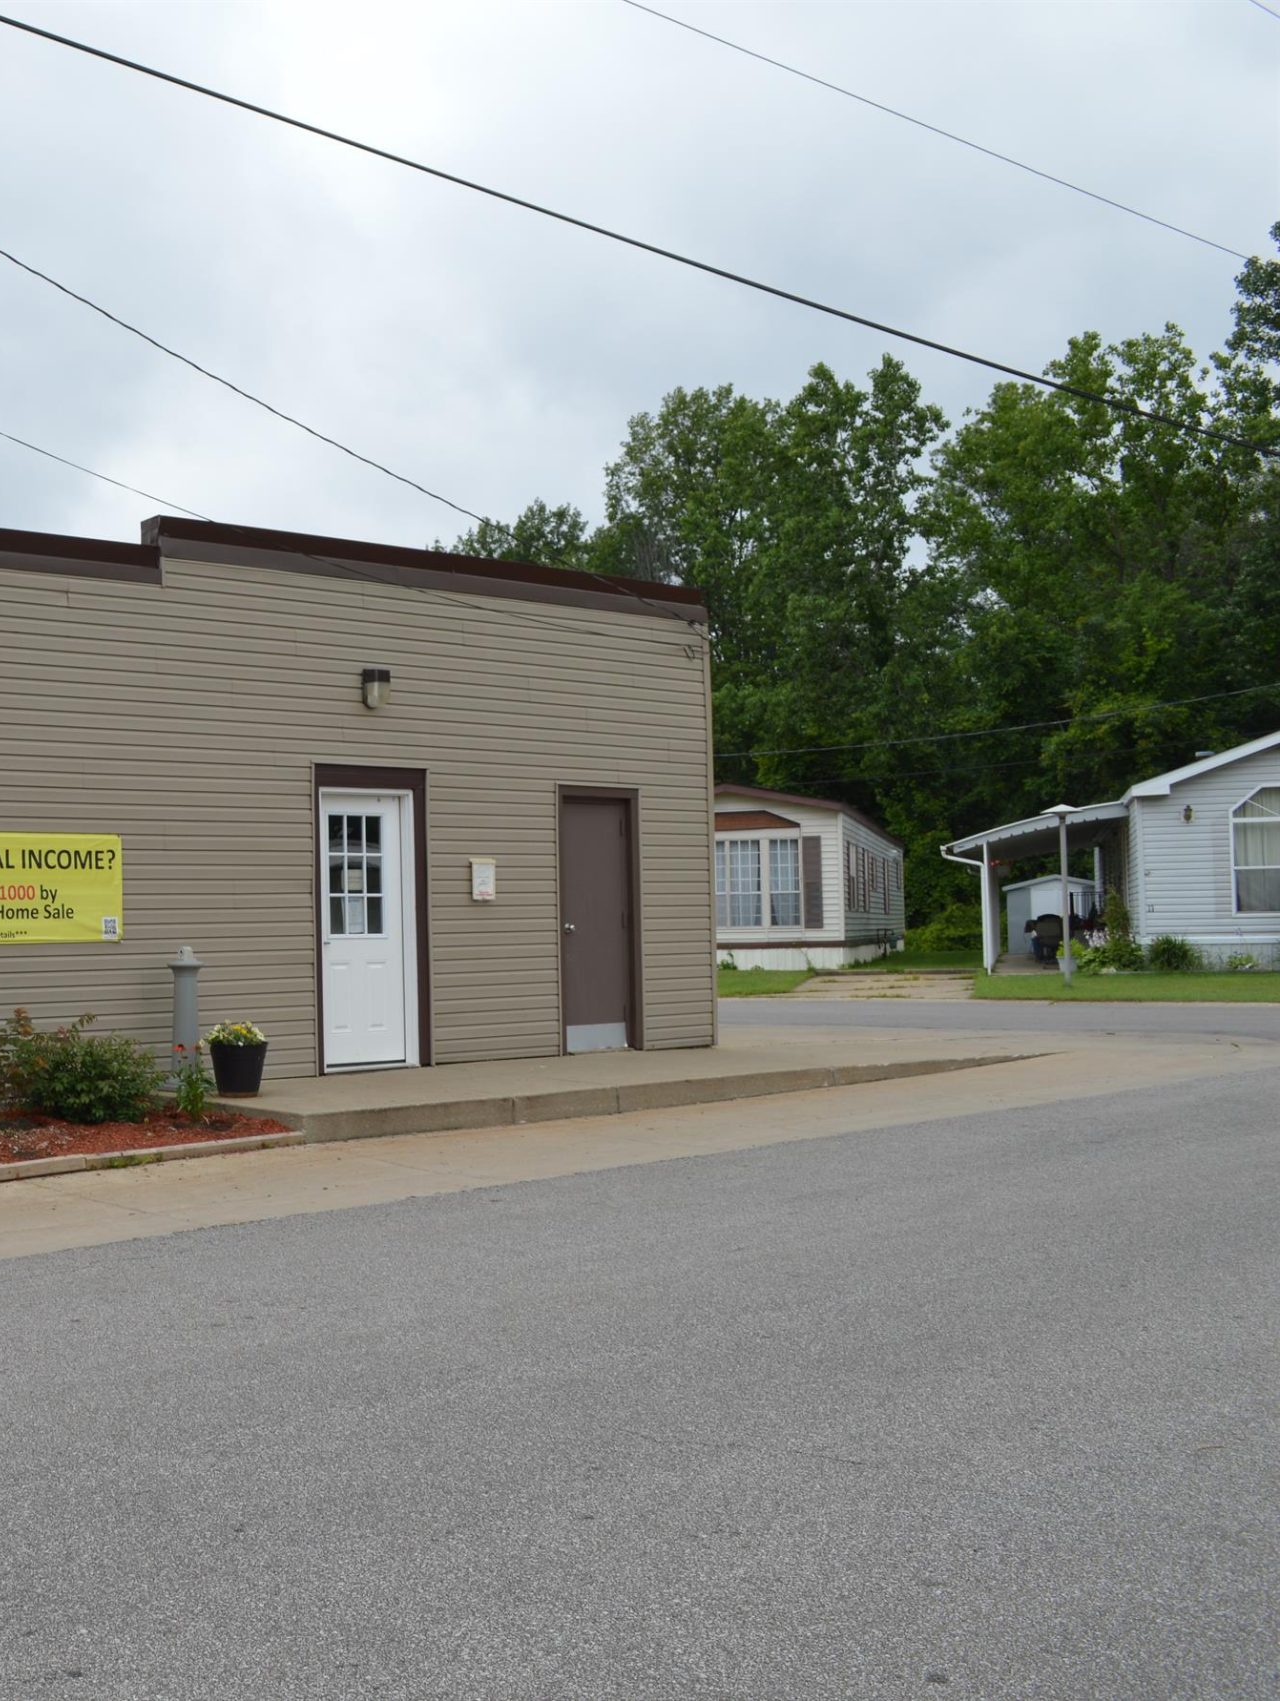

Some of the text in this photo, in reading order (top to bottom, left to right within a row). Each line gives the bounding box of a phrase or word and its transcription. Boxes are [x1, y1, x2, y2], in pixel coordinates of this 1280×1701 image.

[21, 849, 116, 870] INCOME?
[40, 884, 58, 904] by
[43, 903, 74, 920] Sale
